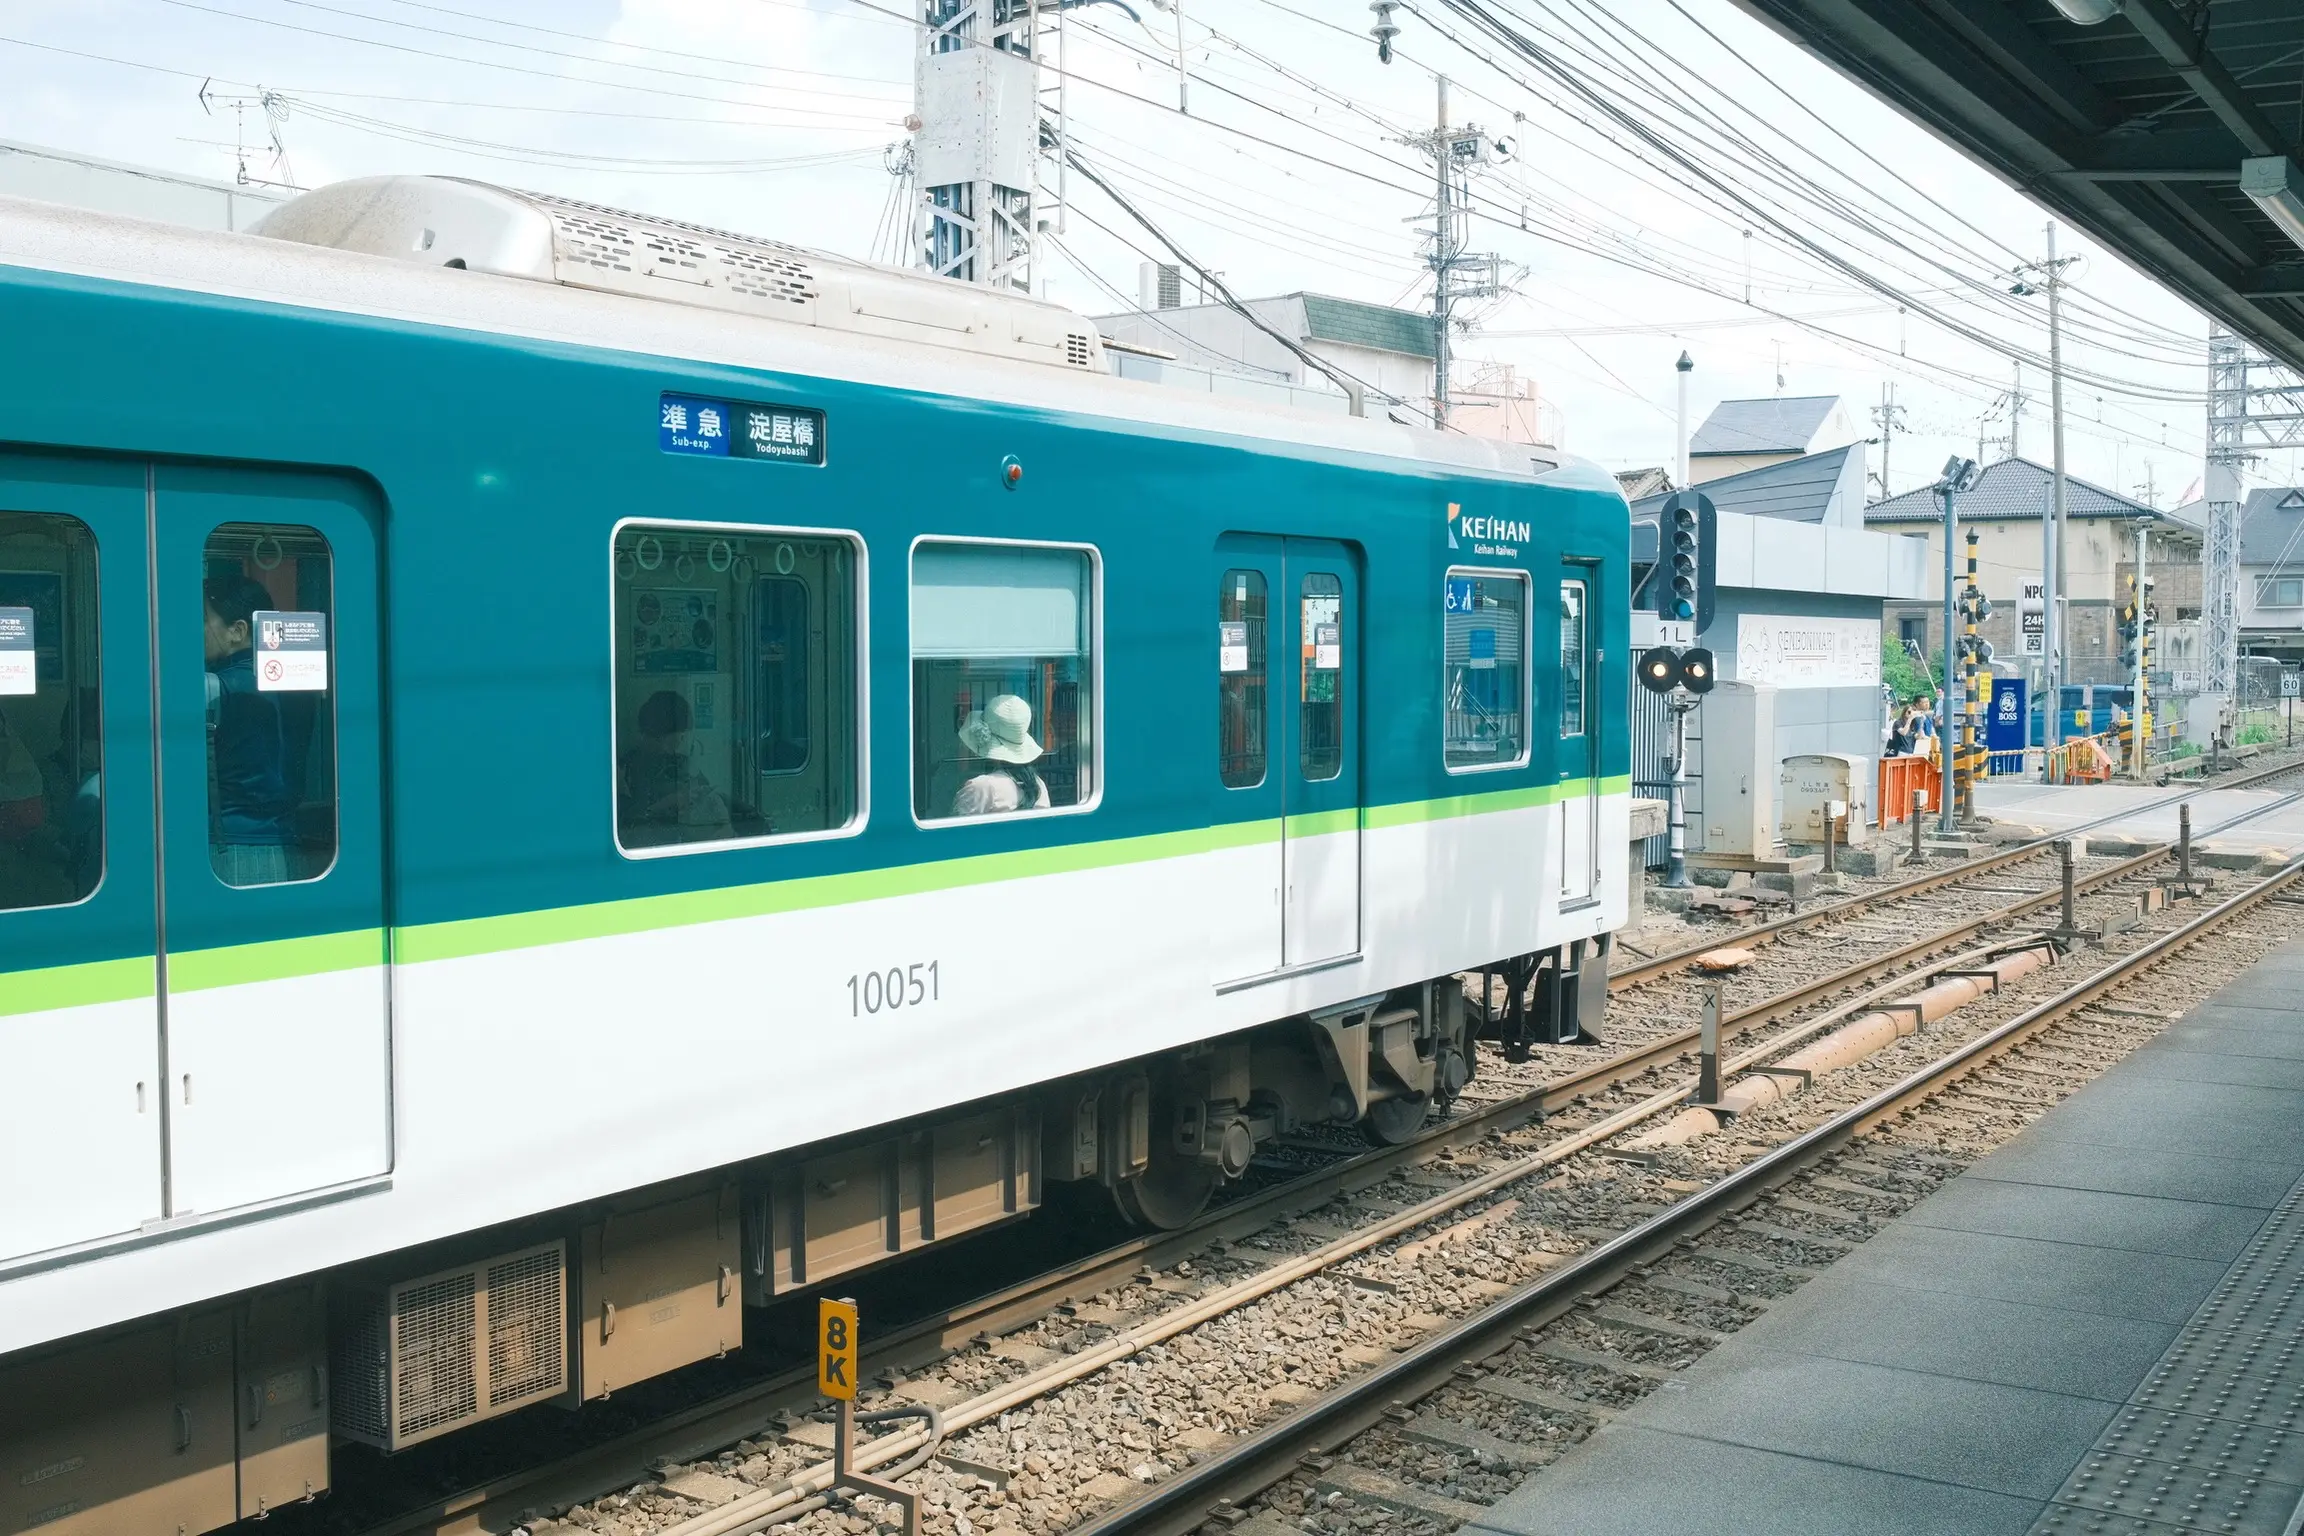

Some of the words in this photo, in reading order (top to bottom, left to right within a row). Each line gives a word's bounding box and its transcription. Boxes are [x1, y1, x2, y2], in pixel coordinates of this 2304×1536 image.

[661, 404, 723, 438] 準急
[749, 411, 815, 447] 淀屋橋
[672, 436, 712, 450] Sub-exp.
[755, 442, 809, 457] Yodoyabashi
[1461, 515, 1530, 543] KEIHAN
[1474, 543, 1495, 556] Keihan
[1495, 545, 1518, 560] Railway
[2283, 680, 2297, 690] 60
[1998, 712, 2018, 721] BOSS
[847, 959, 938, 1018] 10051
